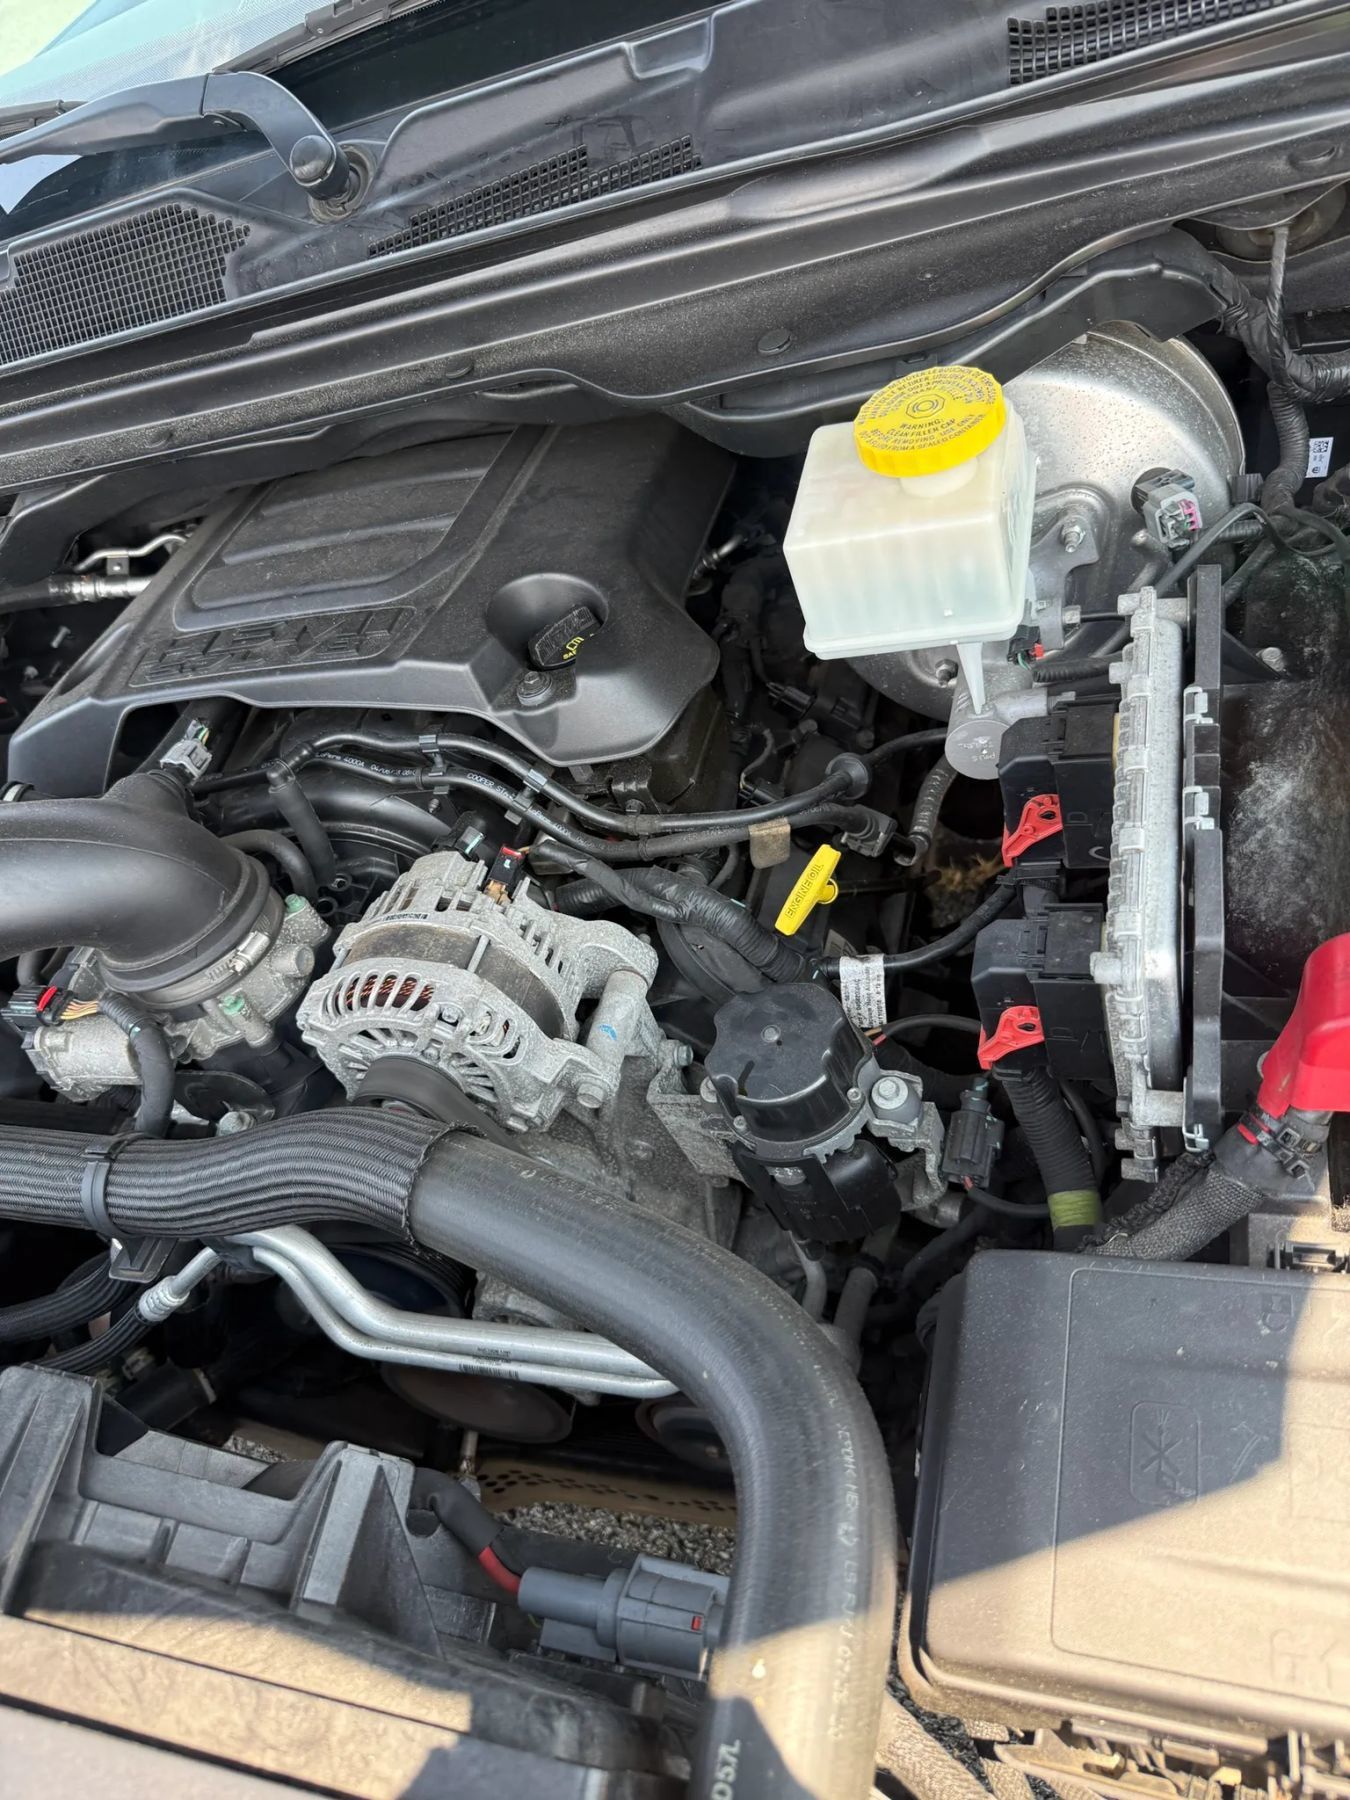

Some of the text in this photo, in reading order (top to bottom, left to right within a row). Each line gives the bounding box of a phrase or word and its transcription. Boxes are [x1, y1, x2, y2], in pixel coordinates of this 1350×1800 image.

[467, 772, 494, 788] COOPER
[785, 864, 824, 919] ENGINE OIL
